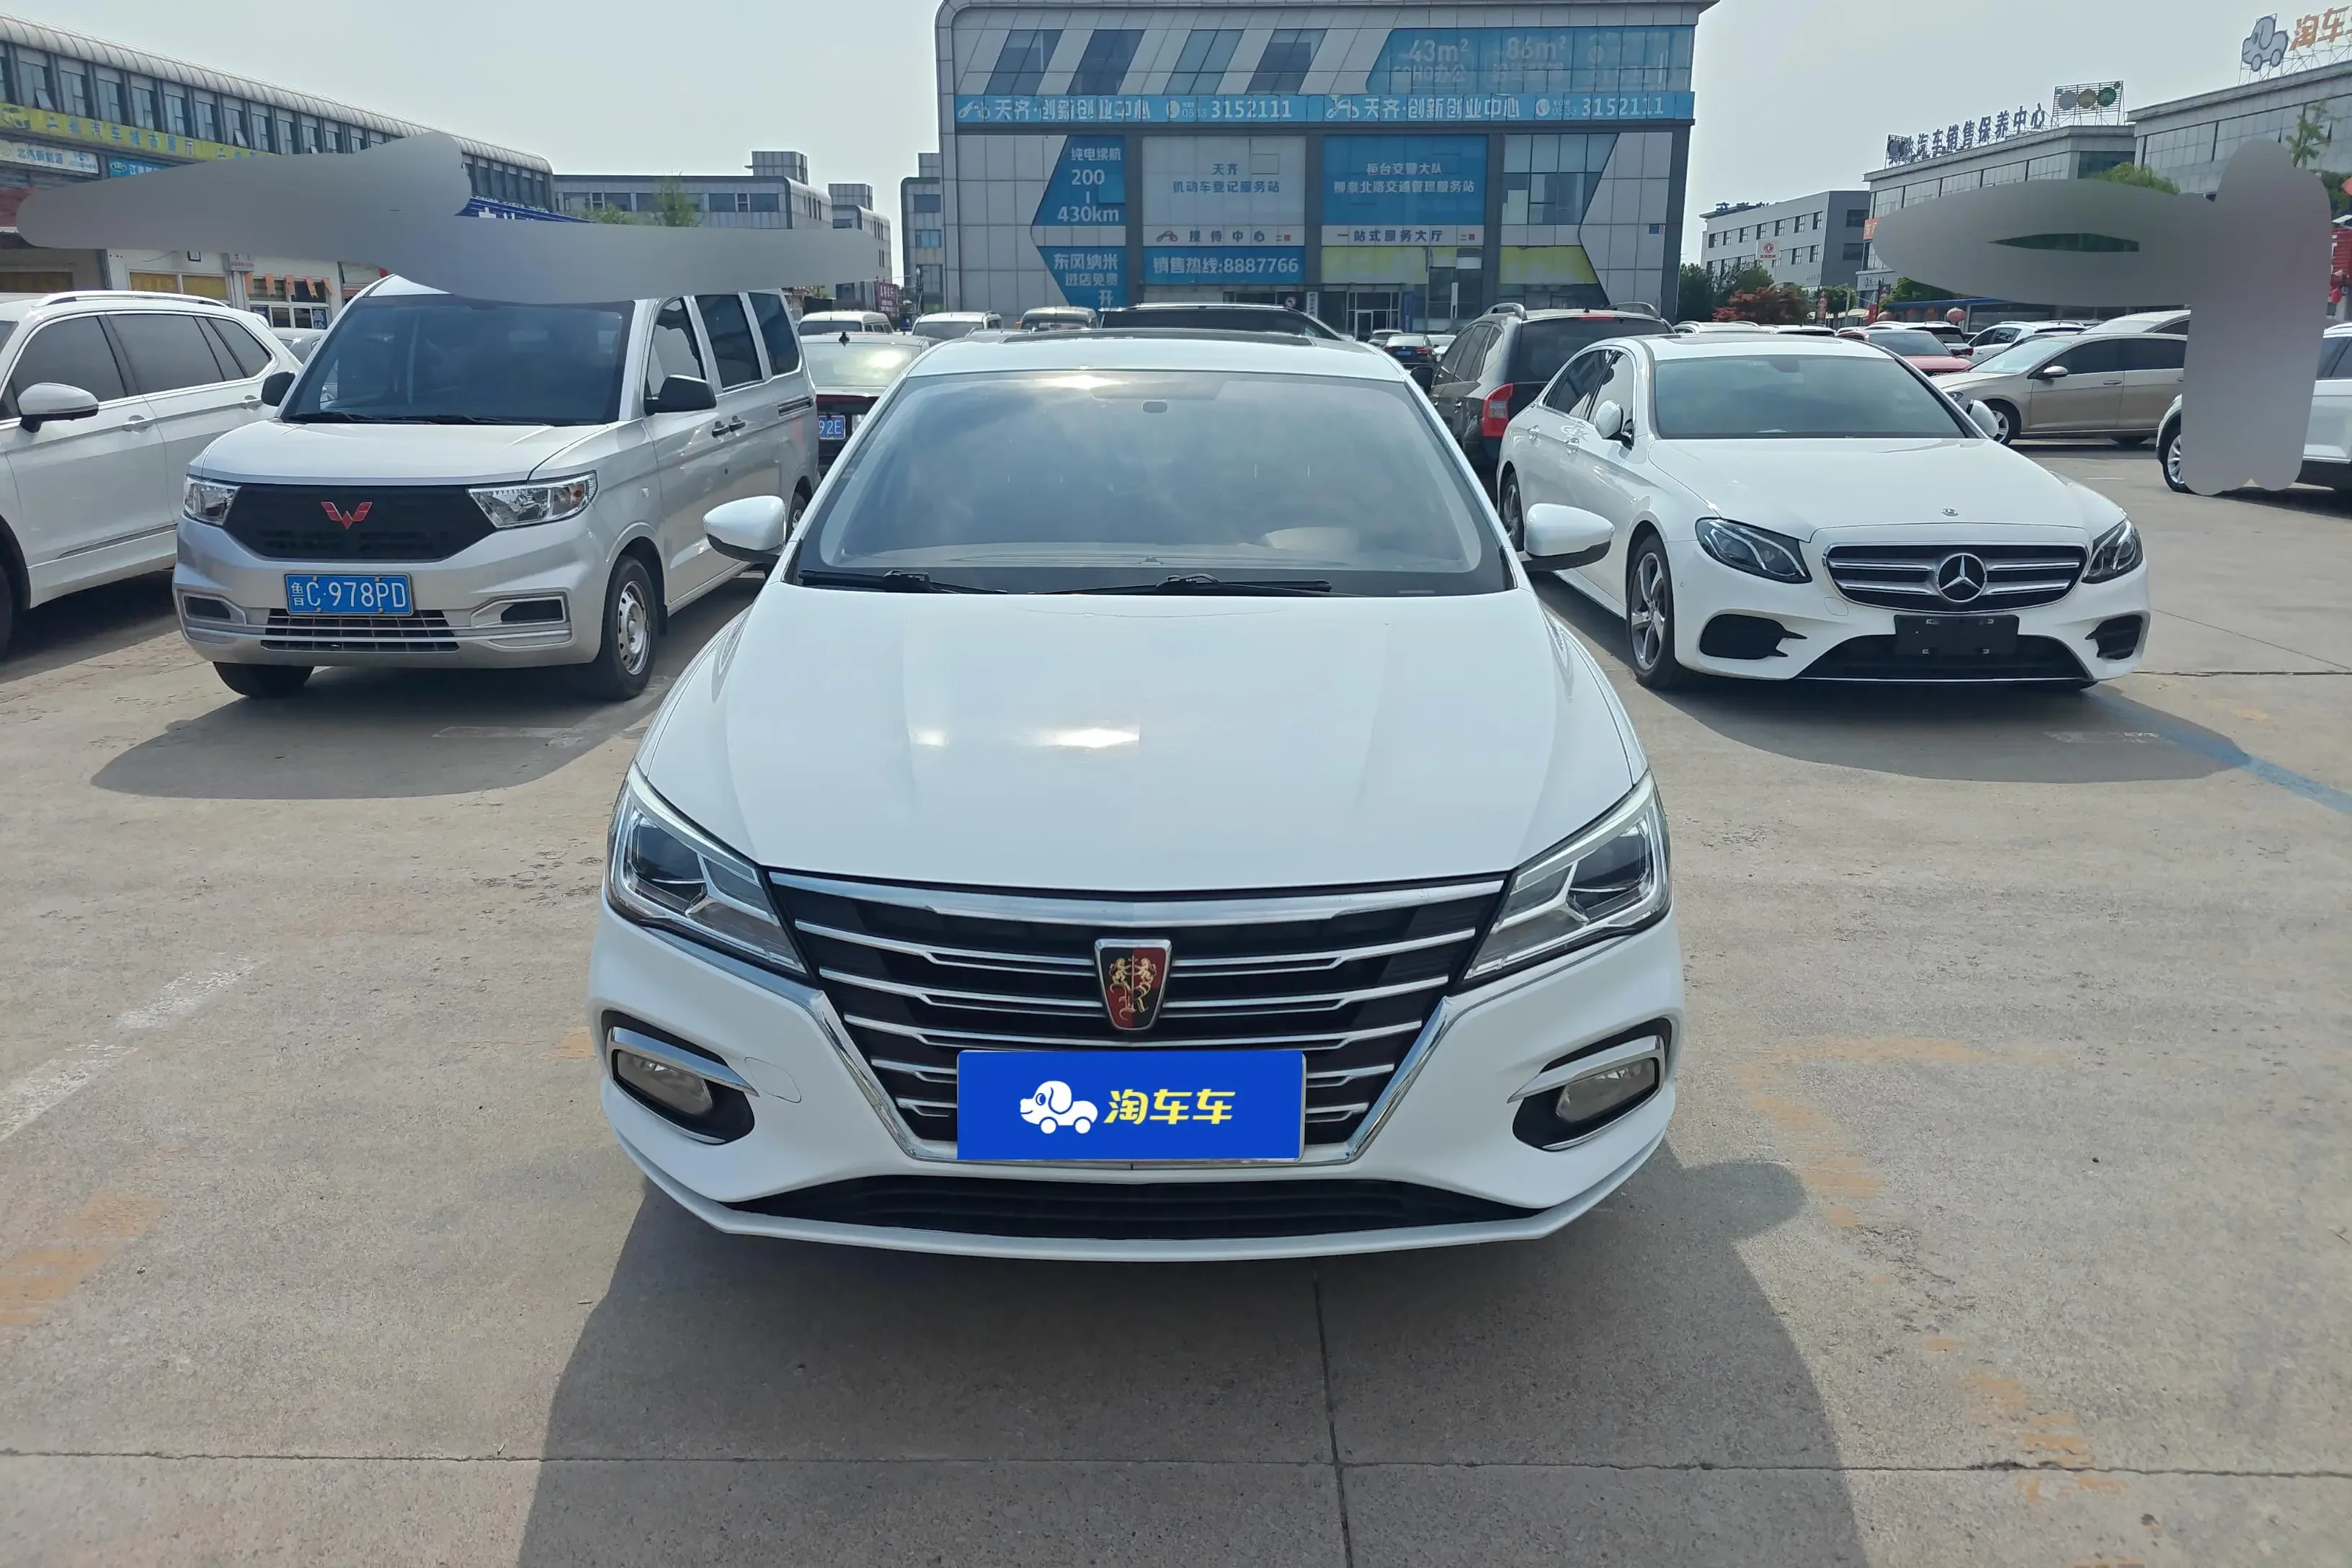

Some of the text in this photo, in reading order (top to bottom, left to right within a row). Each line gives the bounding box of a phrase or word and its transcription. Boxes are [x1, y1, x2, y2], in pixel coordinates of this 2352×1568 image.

[2288, 5, 2352, 51] 淘车
[1211, 99, 1292, 118] 3152111
[1582, 97, 1664, 117] 3152111
[1071, 147, 1121, 161] 纯电续航
[1071, 169, 1105, 185] 200
[1212, 164, 1238, 175] 天齐
[1173, 181, 1280, 193] 机动车登记服务站
[1057, 206, 1119, 222] 430km
[1189, 230, 1265, 242] 接待中心
[1337, 229, 1443, 242] 一站式服务大厅
[1054, 253, 1118, 270] 东风纳米
[1065, 273, 1118, 286] 进店免费
